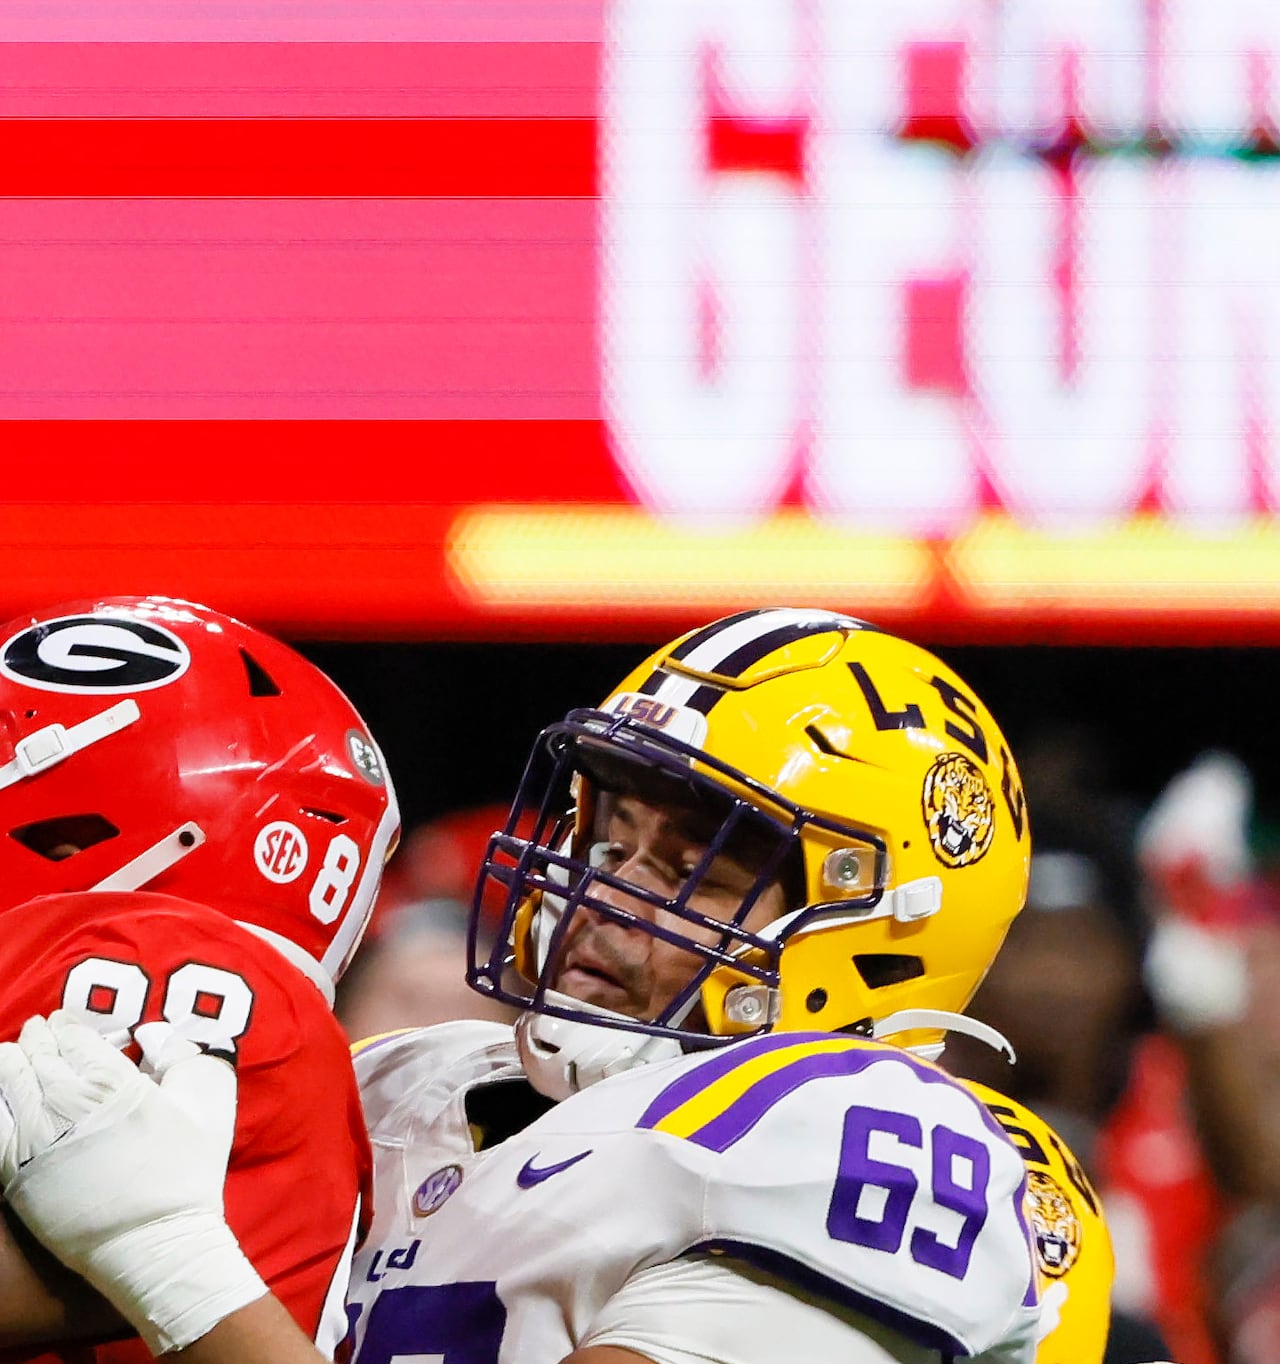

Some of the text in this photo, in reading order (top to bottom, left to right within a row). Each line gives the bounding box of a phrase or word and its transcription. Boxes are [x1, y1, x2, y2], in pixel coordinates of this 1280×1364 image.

[20, 618, 190, 682] G
[612, 695, 678, 728] LSU
[261, 828, 302, 878] SEC
[308, 833, 361, 926] 8
[826, 1105, 991, 1281] 69
